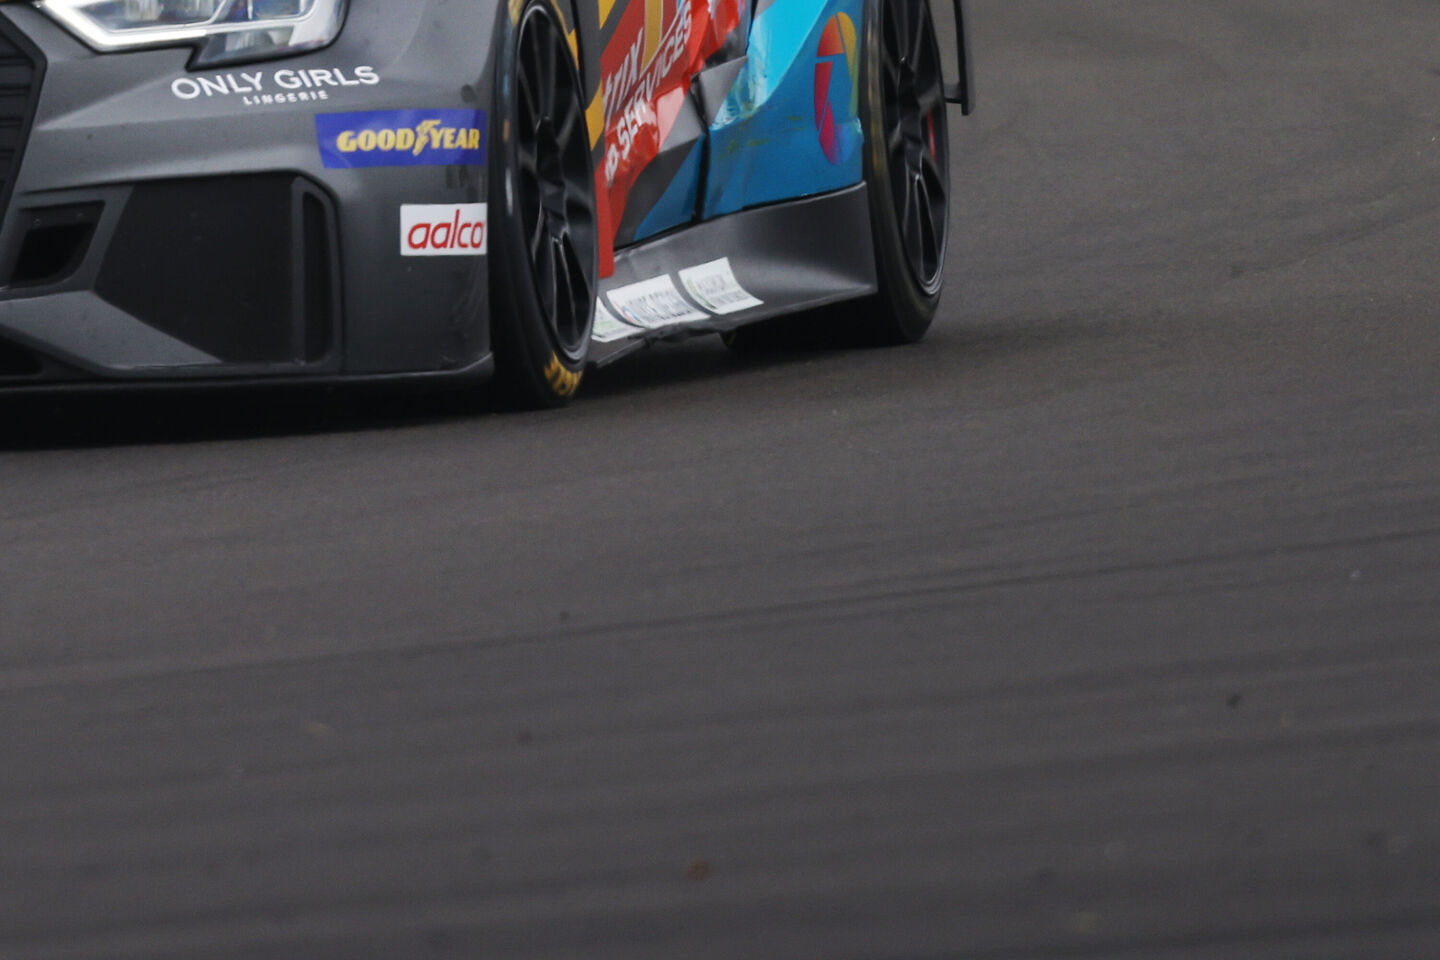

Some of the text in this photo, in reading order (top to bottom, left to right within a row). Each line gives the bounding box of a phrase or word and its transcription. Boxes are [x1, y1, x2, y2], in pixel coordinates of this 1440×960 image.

[171, 66, 380, 100] ONLY GIRLS
[242, 89, 329, 106] LINGERIE
[336, 119, 481, 156] GOODYEAR
[407, 208, 484, 251] aalco
